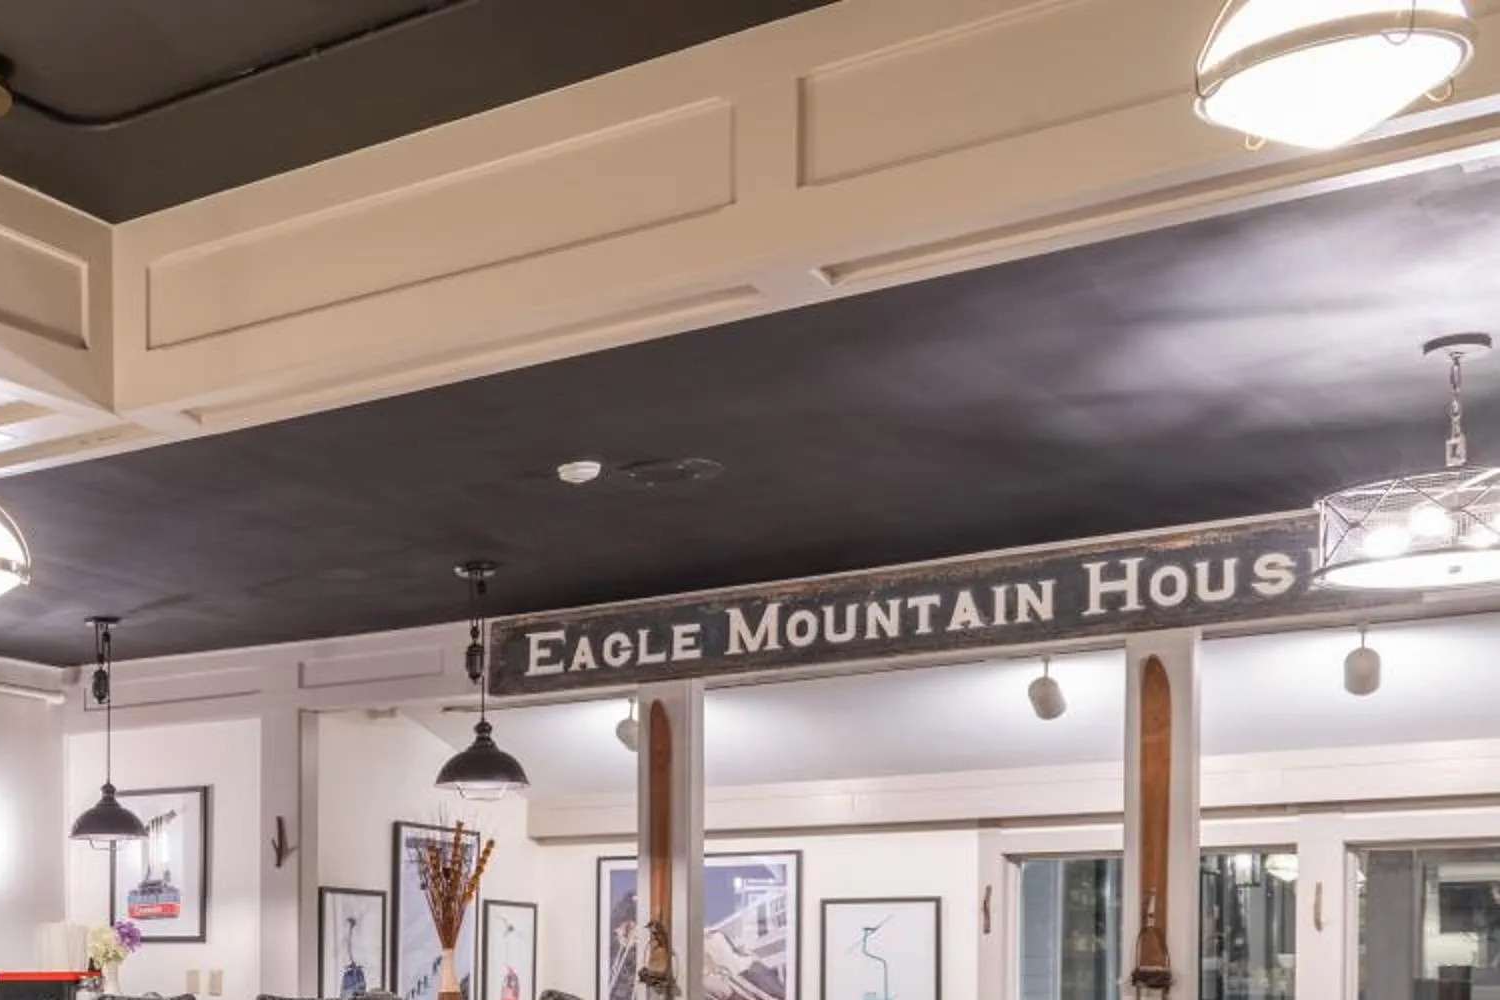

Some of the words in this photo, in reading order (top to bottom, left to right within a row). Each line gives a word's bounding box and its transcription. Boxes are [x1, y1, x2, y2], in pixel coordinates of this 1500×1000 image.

[524, 623, 702, 676] EAGLE
[724, 579, 1056, 655] MOUNTAIN
[1080, 547, 1322, 616] HOUS
